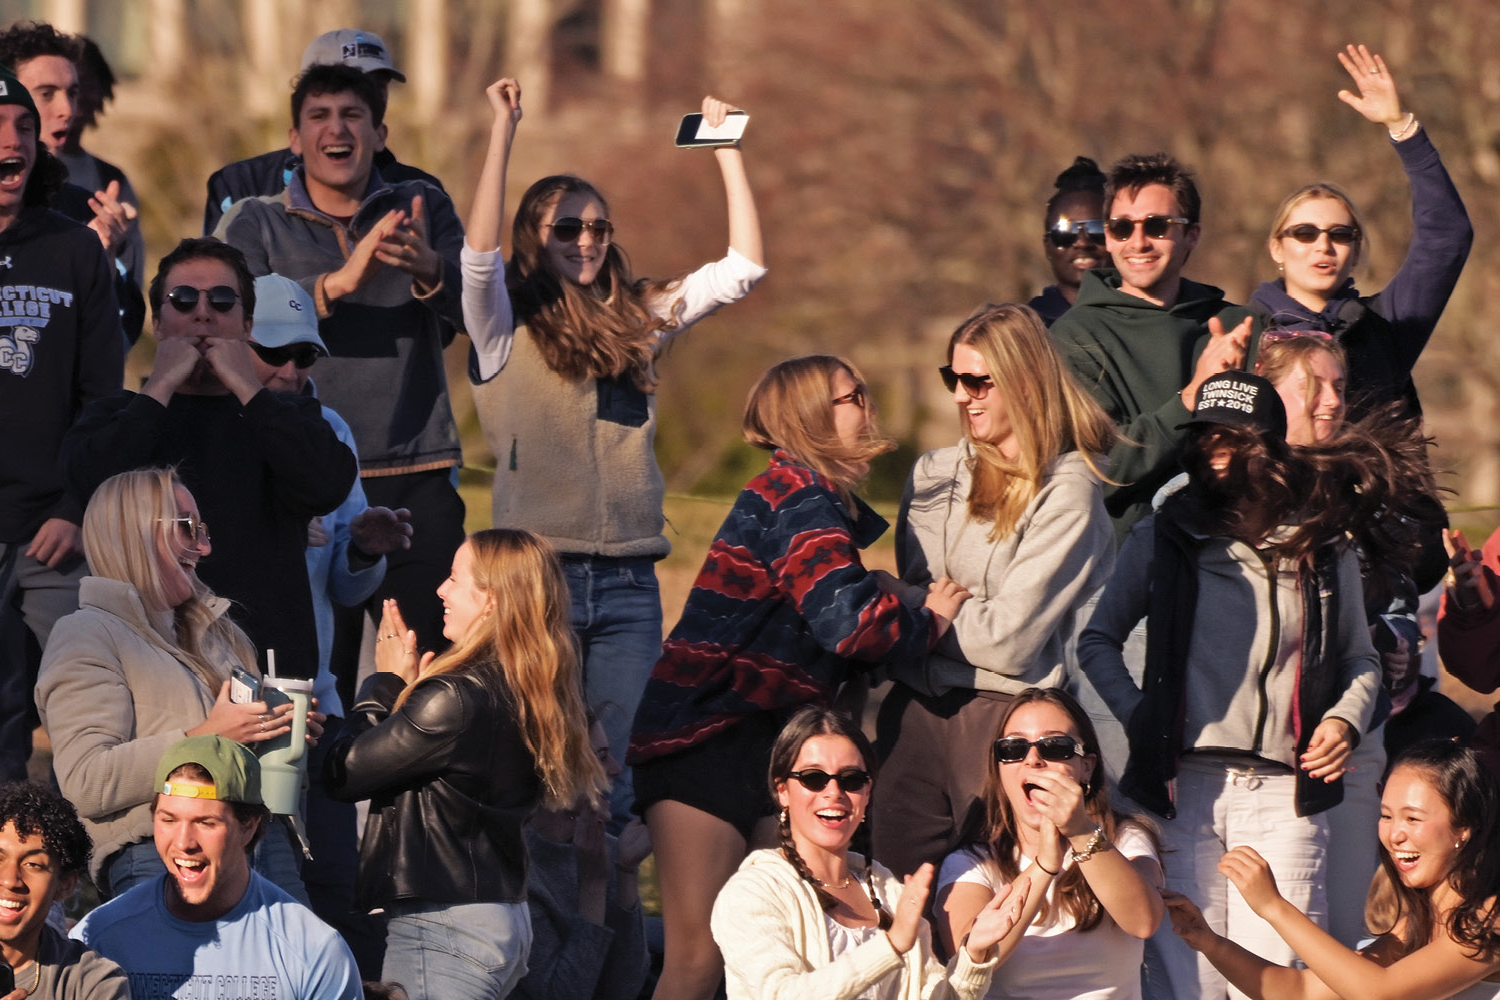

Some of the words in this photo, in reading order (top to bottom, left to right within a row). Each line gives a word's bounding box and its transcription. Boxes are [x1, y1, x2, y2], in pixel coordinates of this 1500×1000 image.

[1202, 380, 1231, 392] LONG
[1232, 381, 1259, 396] LIVE
[1202, 389, 1255, 404] TWINSICK
[1197, 399, 1217, 411] EST
[1225, 399, 1254, 414] 2019
